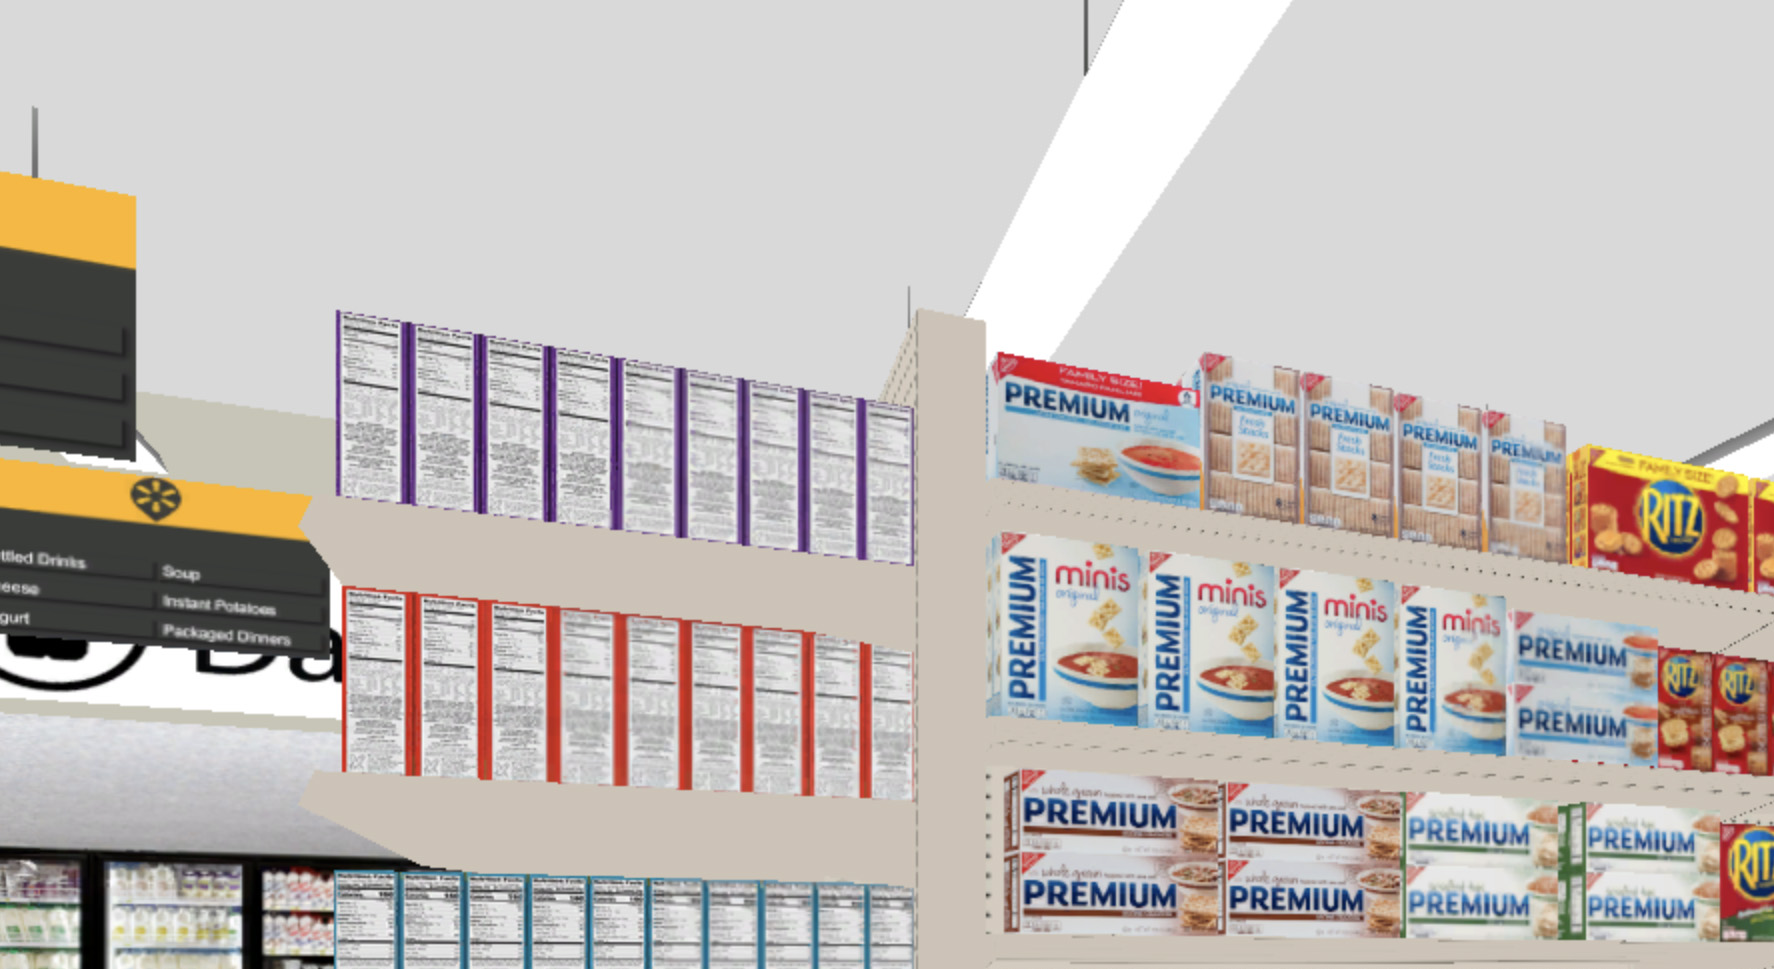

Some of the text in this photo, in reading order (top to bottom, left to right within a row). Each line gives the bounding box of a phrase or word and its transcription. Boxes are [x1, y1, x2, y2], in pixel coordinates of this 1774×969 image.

[1005, 381, 1130, 424] PREMIUM
[1209, 383, 1297, 417] PREMIUM
[1310, 402, 1391, 432] PREMIUM
[1403, 423, 1478, 450] PREMIUM
[1640, 489, 1702, 542] RITZ
[37, 552, 87, 570] Drinks
[162, 564, 201, 583] Soup
[1055, 560, 1131, 592] minis
[162, 595, 277, 616] Instant Potatoes
[1197, 578, 1267, 609] minis
[1324, 593, 1388, 623] minis
[162, 624, 292, 647] Packaged Dinners
[1008, 555, 1037, 700] PREMIUM
[1442, 609, 1501, 637] minis
[1155, 573, 1181, 711] PREMIUM
[1285, 589, 1309, 723] PREMIUM
[1518, 634, 1628, 668] PREMIUM
[1405, 604, 1428, 733] PREMIUM
[1518, 706, 1628, 740] PREMIUM
[1023, 797, 1178, 829] PREMIUM
[1229, 807, 1364, 838] PREMIUM
[1408, 817, 1530, 846] PREMIUM
[1588, 826, 1696, 853] PREMIUM
[1023, 879, 1178, 909] PREMIUM
[1229, 885, 1364, 913] PREMIUM
[1408, 890, 1530, 917] PREMIUM
[1588, 895, 1696, 921] PREMIUM
